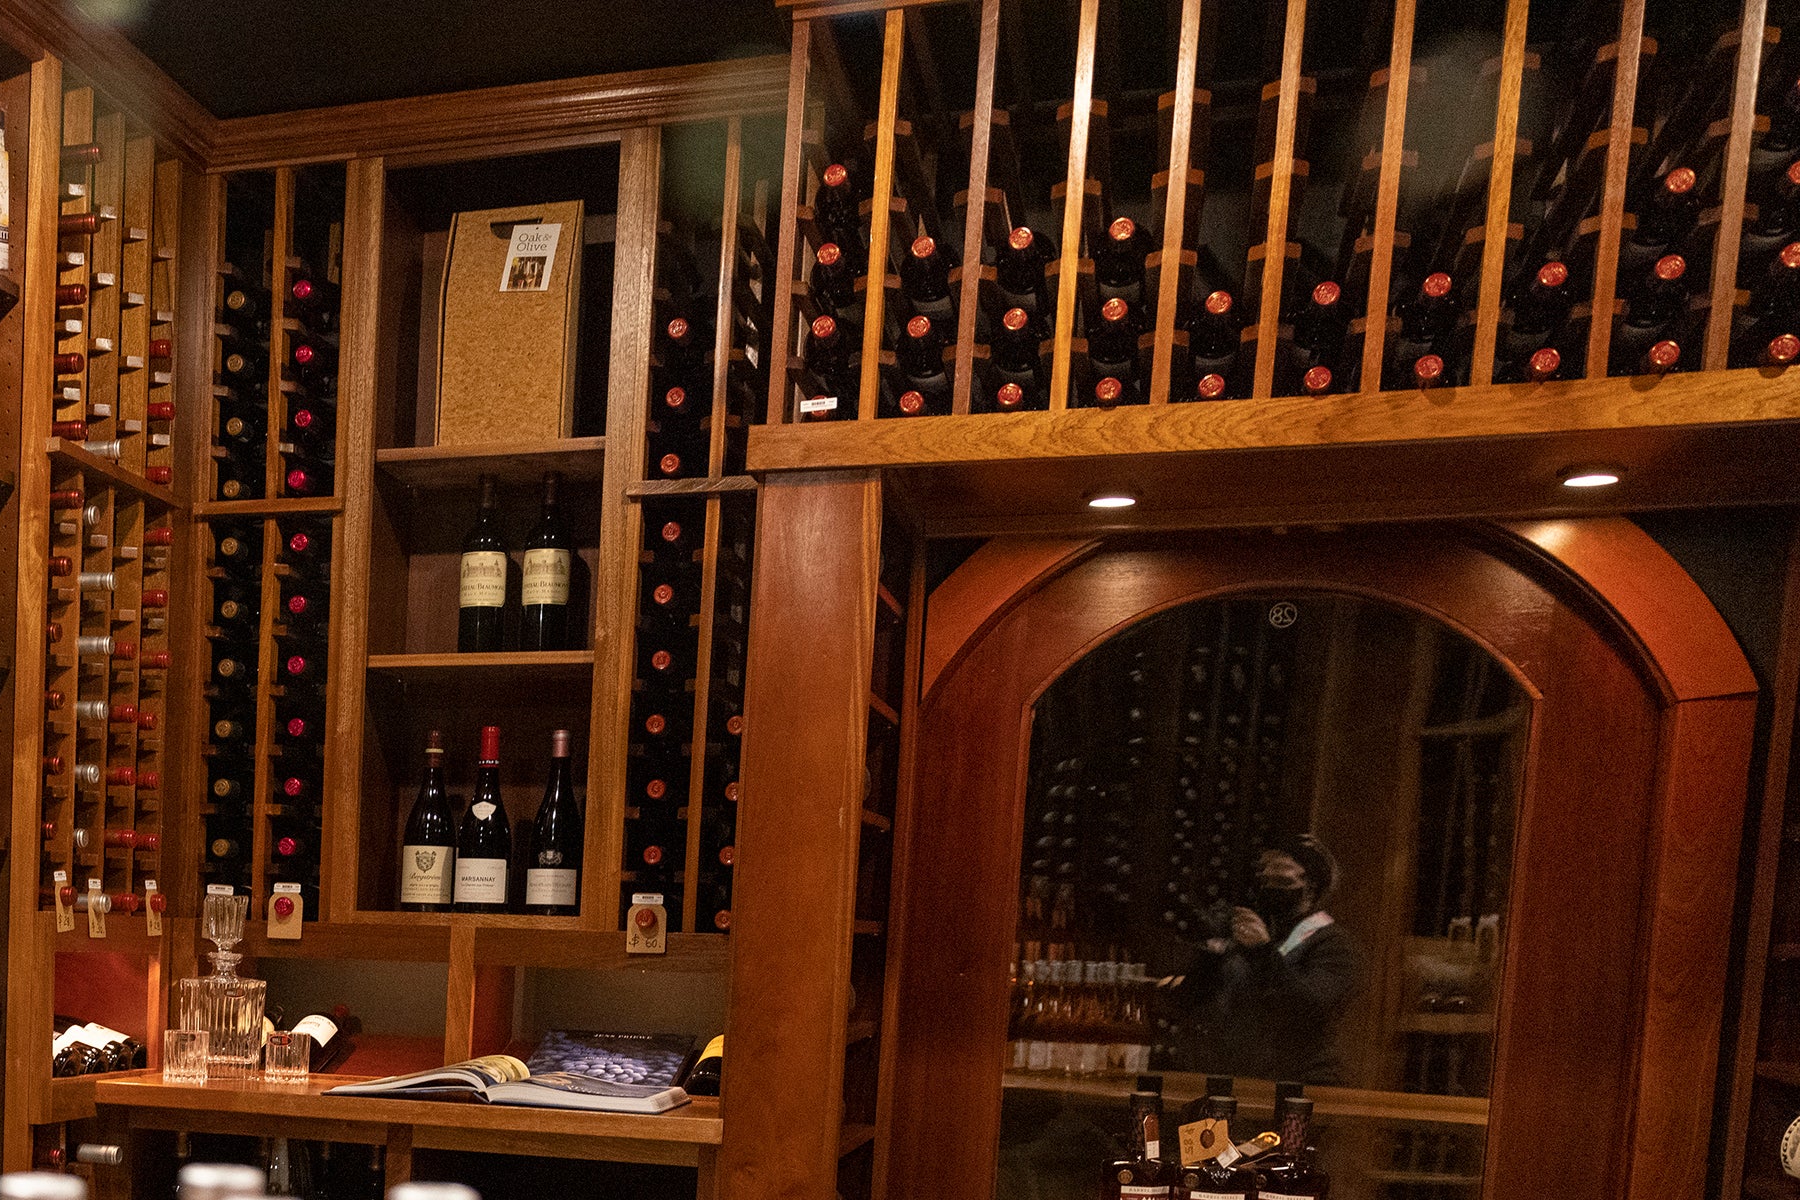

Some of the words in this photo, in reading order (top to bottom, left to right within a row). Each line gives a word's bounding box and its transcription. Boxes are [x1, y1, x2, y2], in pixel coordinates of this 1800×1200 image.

[519, 233, 541, 242] Oak
[517, 242, 547, 252] Olive
[628, 934, 640, 947] $
